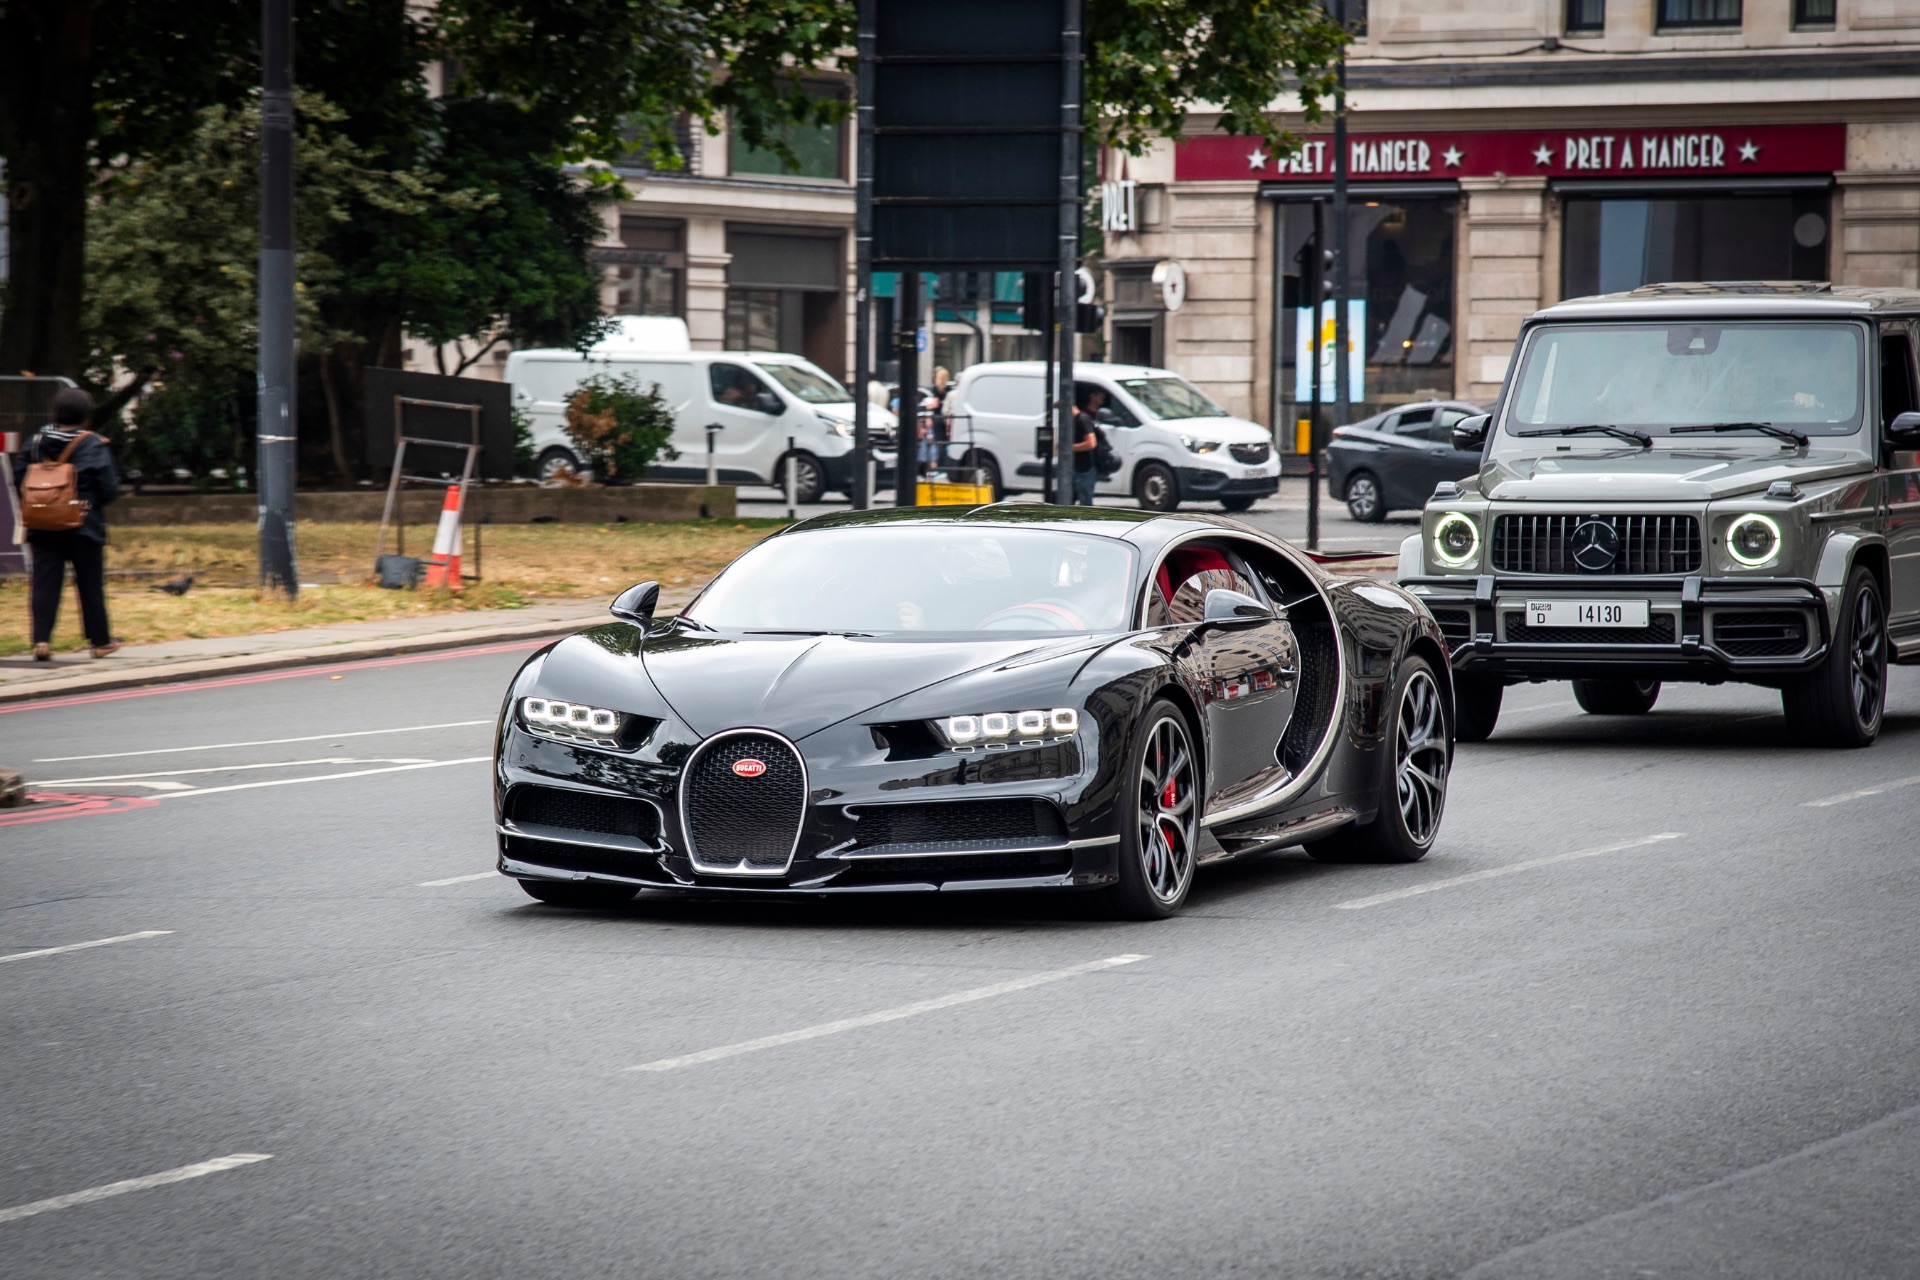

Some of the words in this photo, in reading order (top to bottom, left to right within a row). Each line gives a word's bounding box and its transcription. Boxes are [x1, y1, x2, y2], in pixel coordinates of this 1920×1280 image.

[1351, 140, 1431, 173] MANGER
[1565, 136, 1615, 169] PRET
[1620, 137, 1634, 168] A
[1641, 134, 1725, 168] MANGER
[1537, 612, 1546, 624] D
[1579, 605, 1622, 623] 14130
